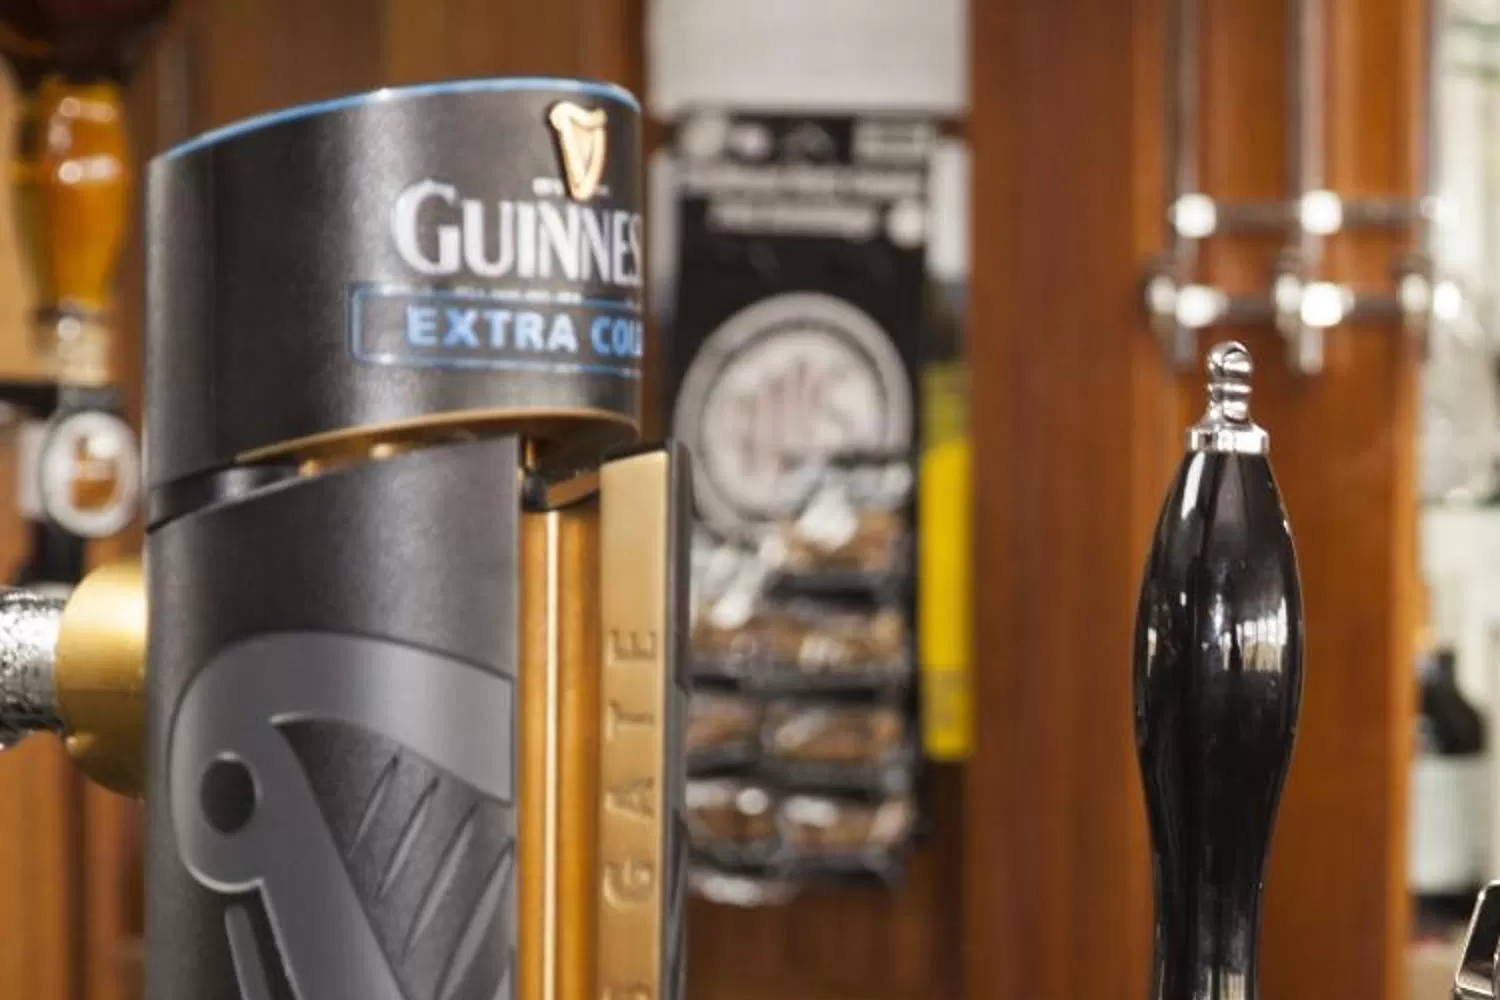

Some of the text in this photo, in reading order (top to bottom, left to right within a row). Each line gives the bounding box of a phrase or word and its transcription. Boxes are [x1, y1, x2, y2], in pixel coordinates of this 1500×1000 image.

[391, 180, 642, 287] GUINNES
[407, 305, 577, 353] EXTRA
[602, 629, 658, 909] GATE
